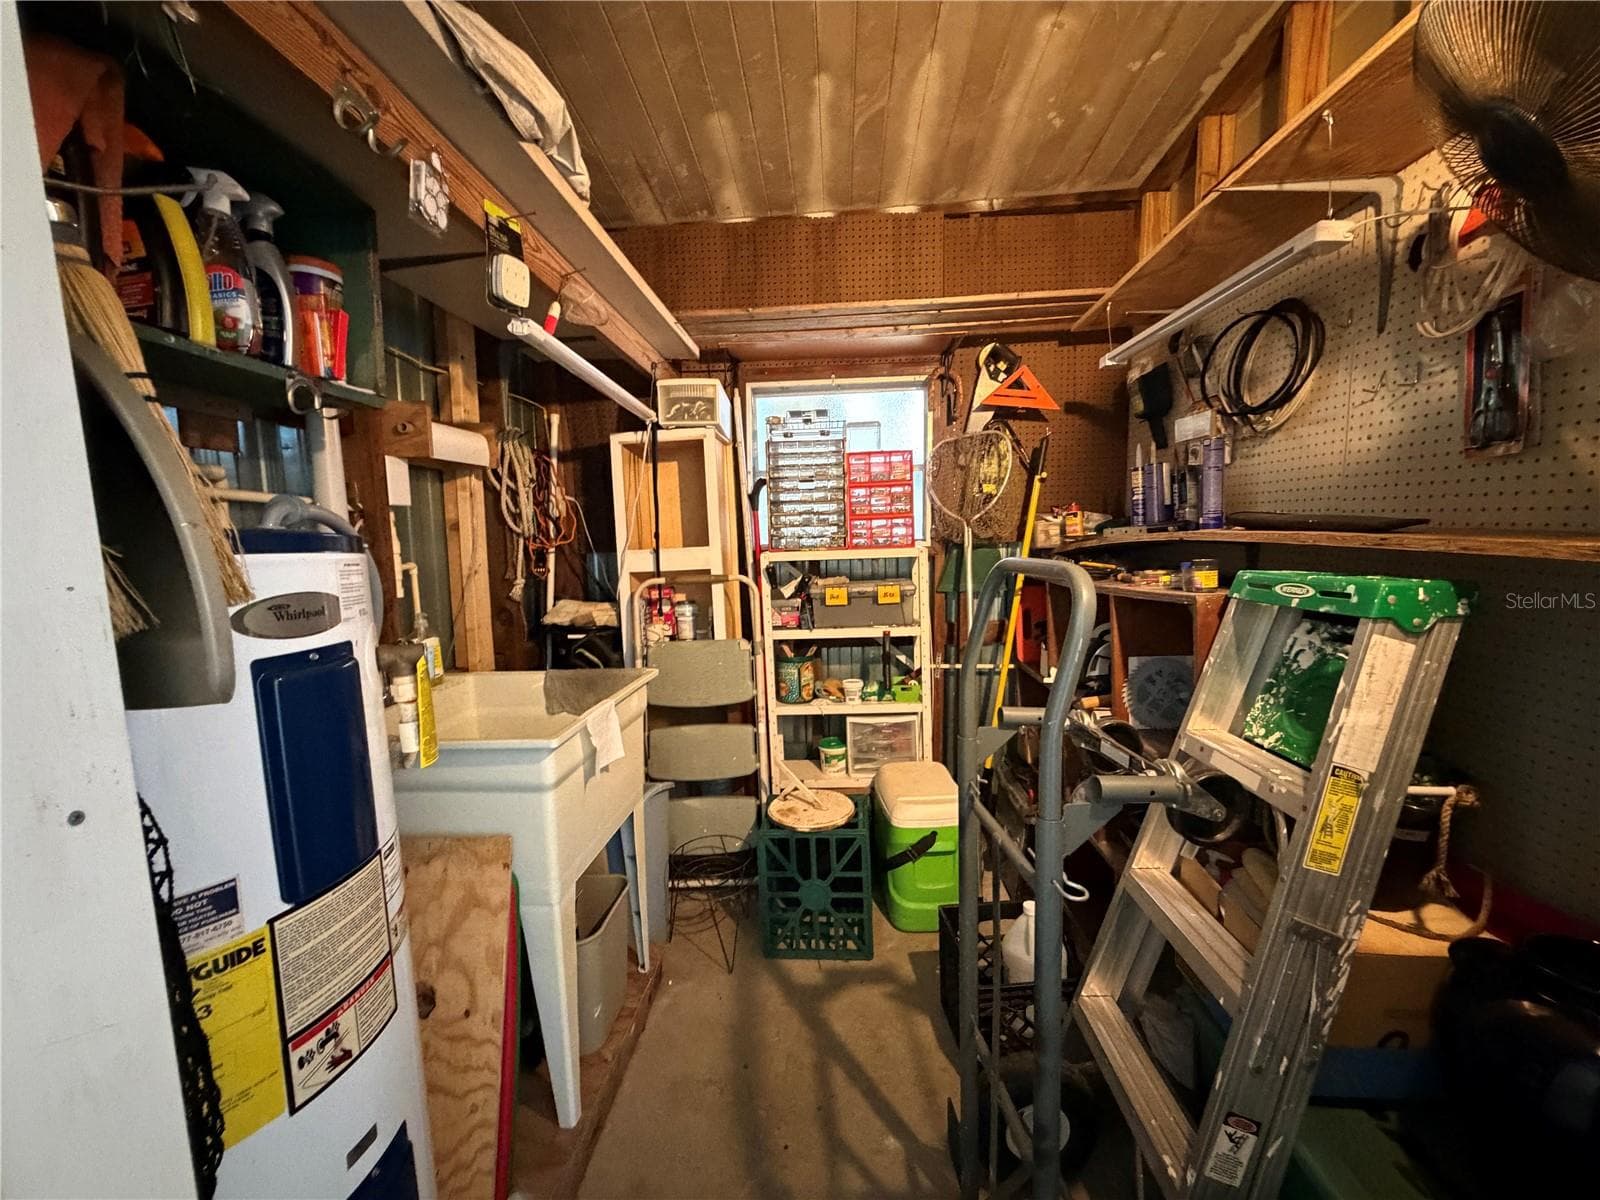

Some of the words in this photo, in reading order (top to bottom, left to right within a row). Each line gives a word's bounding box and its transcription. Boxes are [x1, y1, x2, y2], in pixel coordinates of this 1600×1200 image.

[211, 291, 237, 299] ASICS
[272, 605, 327, 622] Whirlpool
[186, 899, 209, 911] NOT
[181, 919, 233, 944] 77-817-6750
